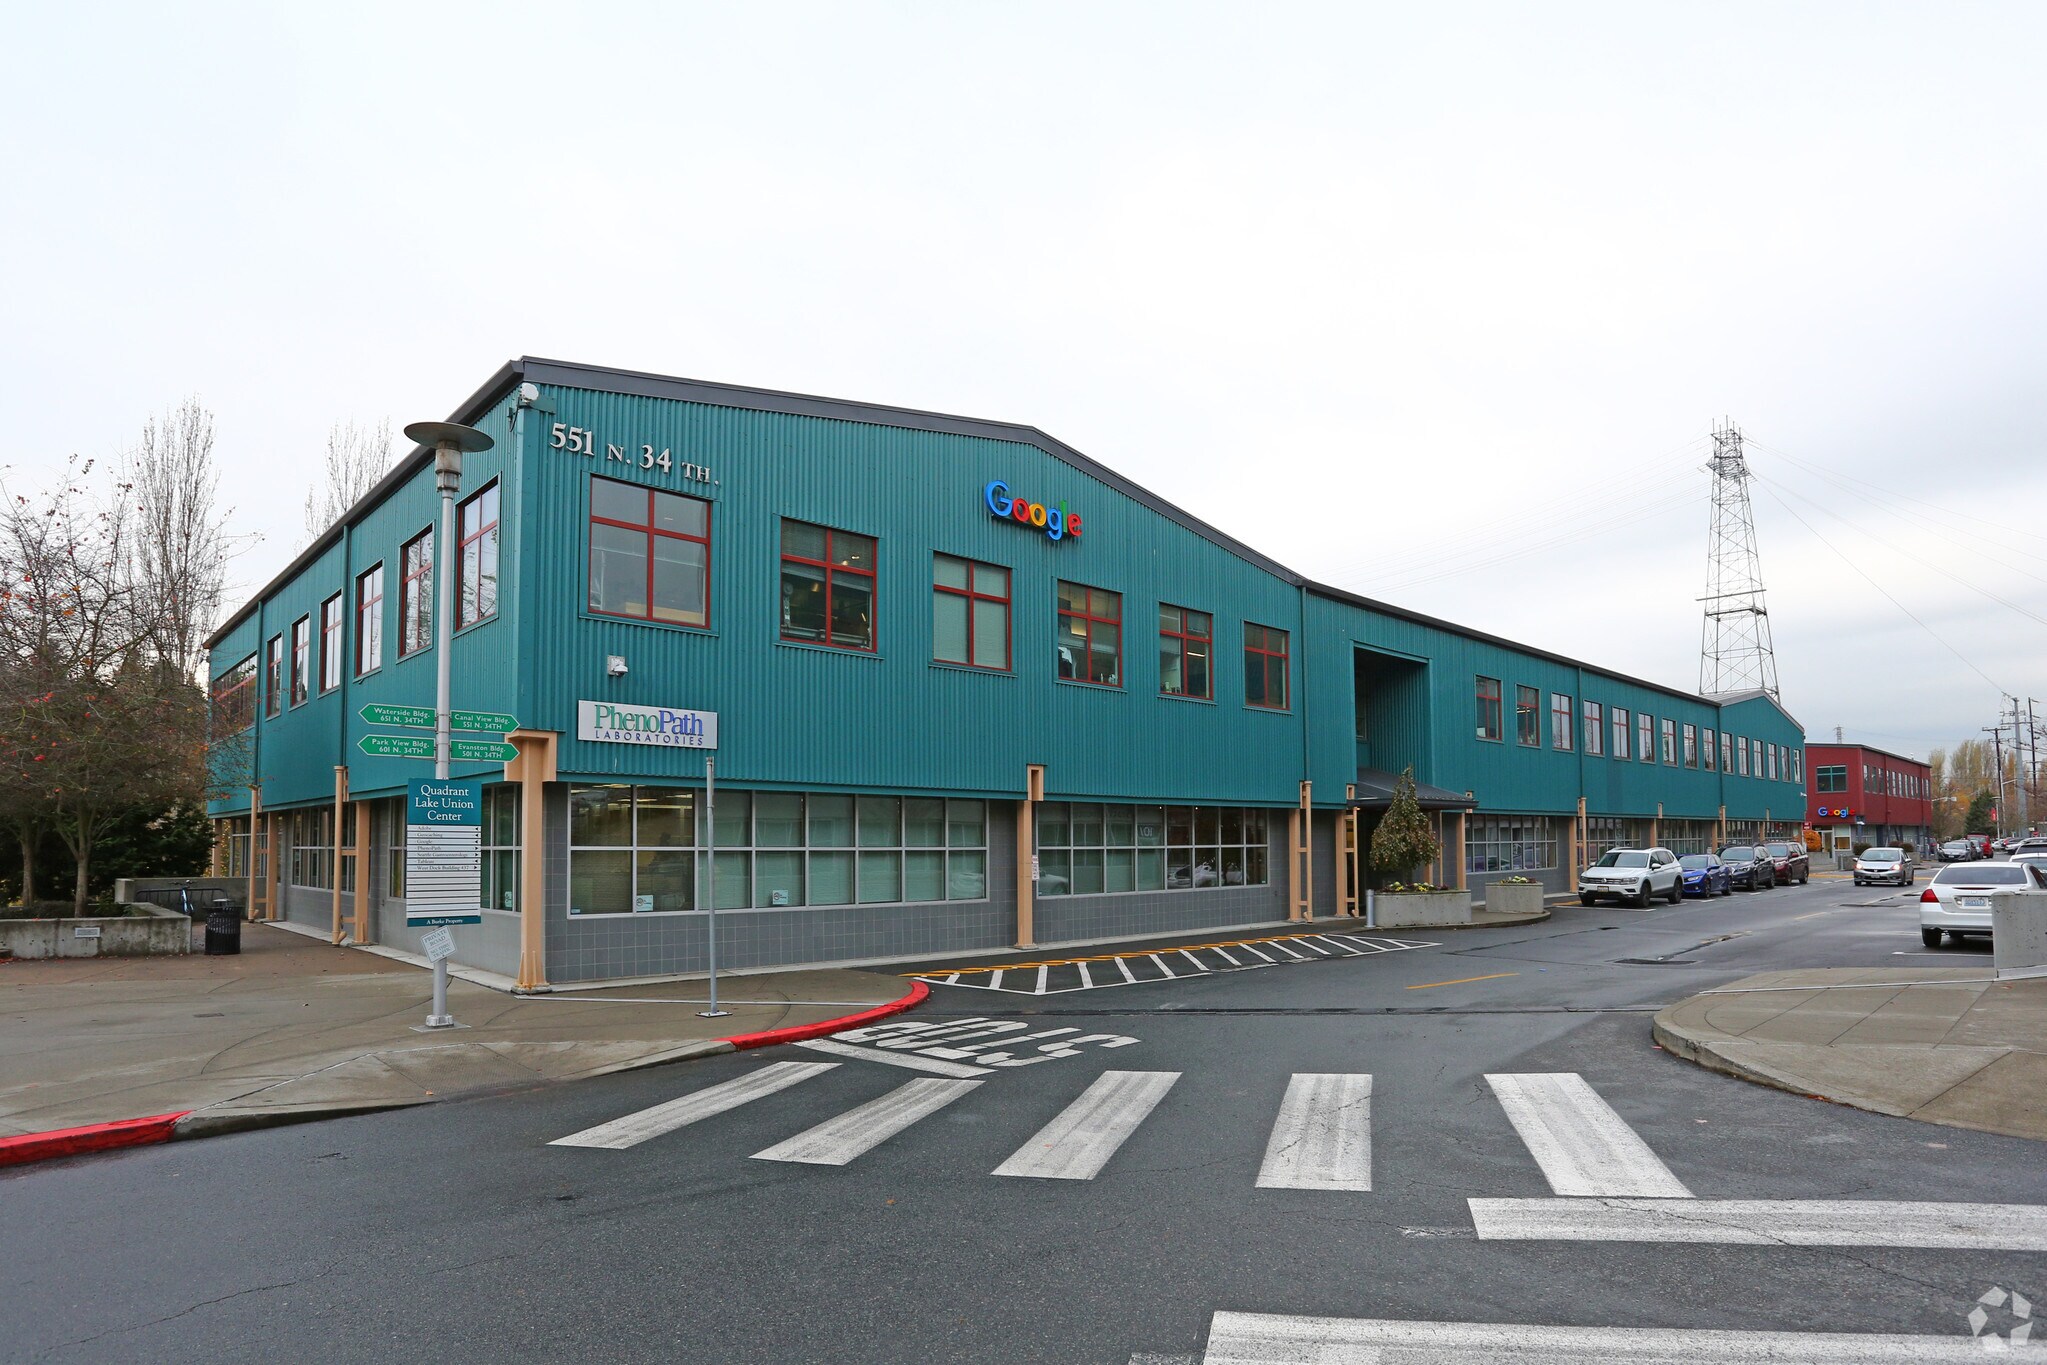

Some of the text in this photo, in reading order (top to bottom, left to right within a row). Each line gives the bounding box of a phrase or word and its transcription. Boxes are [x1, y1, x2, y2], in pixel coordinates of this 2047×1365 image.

[550, 422, 595, 456] 551
[607, 443, 632, 464] N.
[639, 444, 672, 474] 34
[985, 479, 1083, 541] Google
[374, 707, 430, 719] Waterside Bldg.
[494, 716, 510, 724] Bldg.
[594, 704, 704, 736] PhenoPath
[412, 740, 429, 748] Bldg.
[595, 730, 703, 746] LABORATORIES
[421, 784, 469, 797] Quadrant
[415, 797, 474, 808] Lake Union
[427, 810, 462, 820] Center
[1818, 806, 1856, 818] Google
[424, 930, 446, 943] PRIVATE
[430, 936, 446, 946] ROAD
[830, 1017, 1142, 1067] STOP
